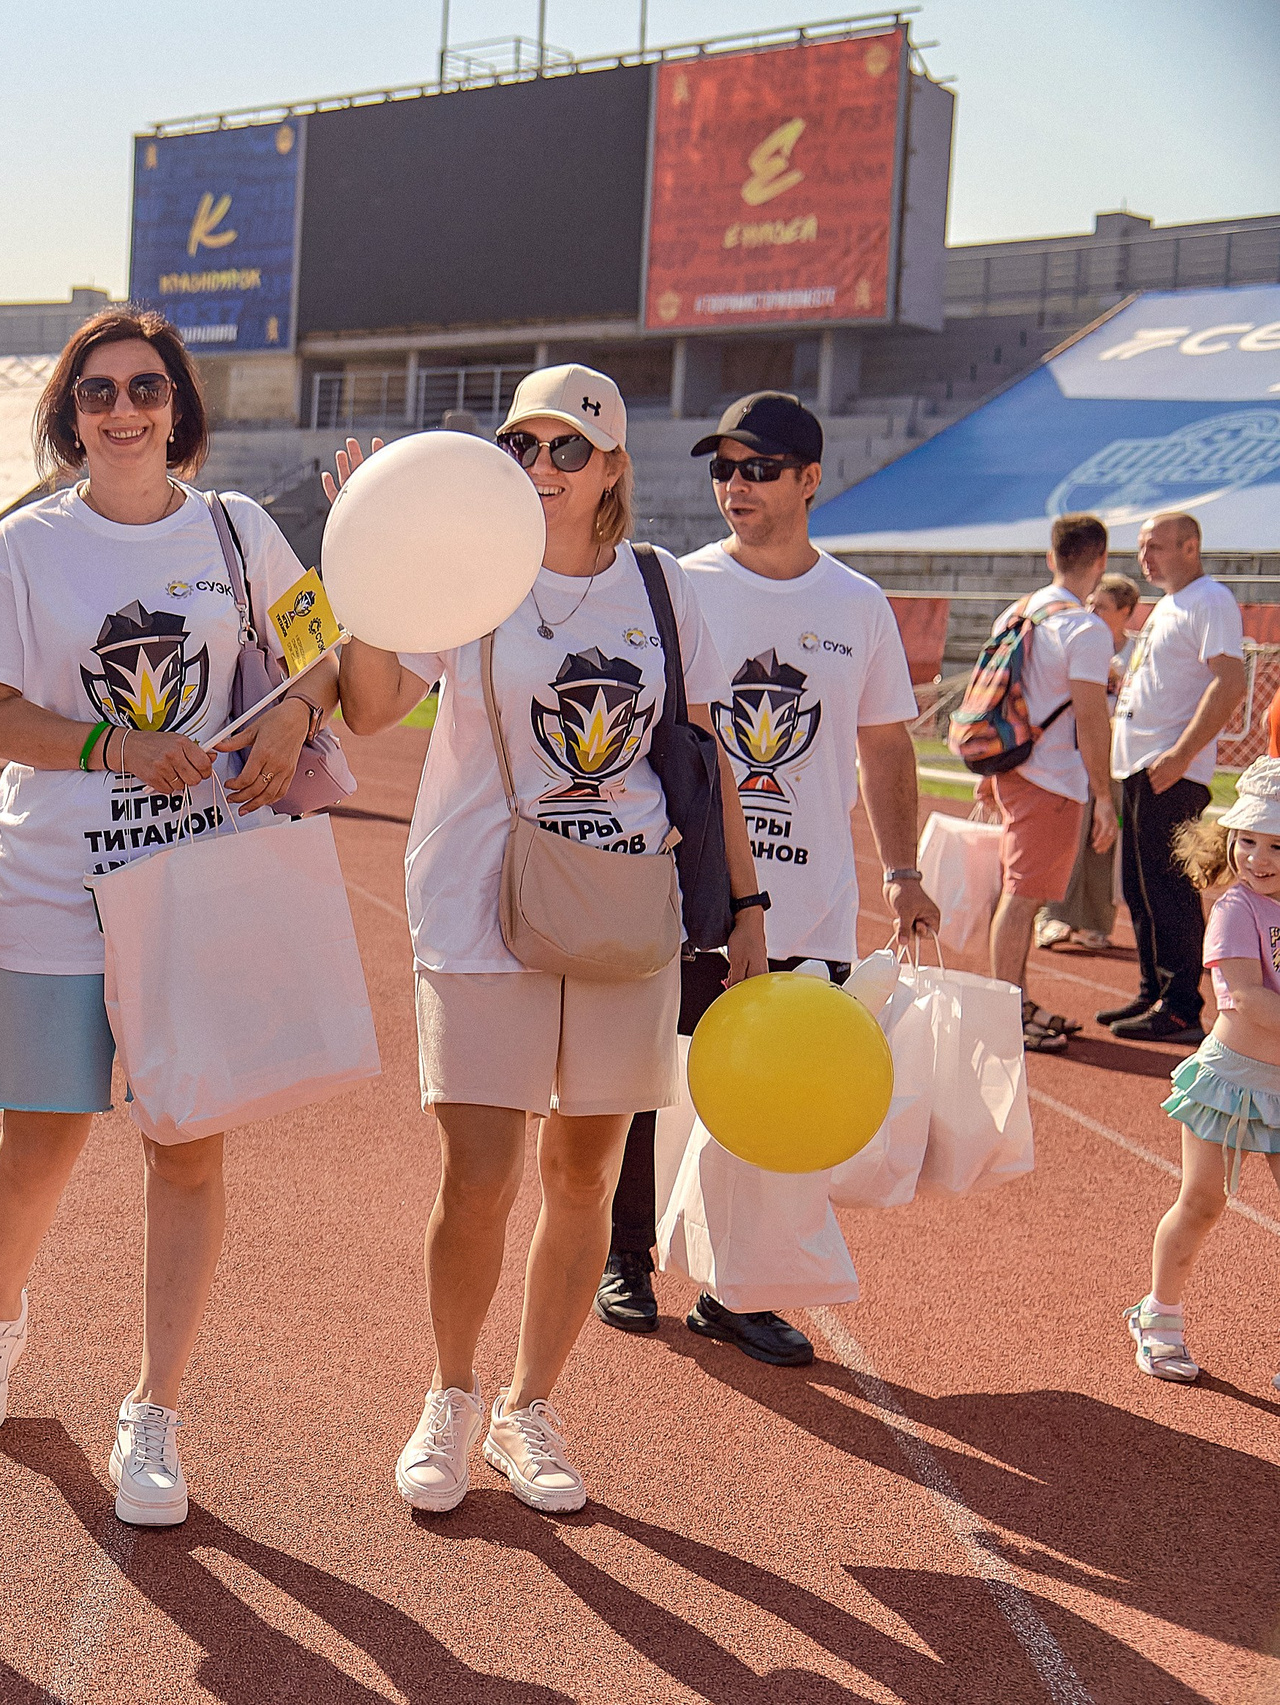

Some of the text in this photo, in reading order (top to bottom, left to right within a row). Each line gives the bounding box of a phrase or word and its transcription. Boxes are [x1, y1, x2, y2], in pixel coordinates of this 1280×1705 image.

[196, 581, 234, 598] СУЭК
[823, 640, 853, 657] СУЭК
[111, 786, 193, 821] ИГРЫ
[84, 805, 224, 853] ТИТАНОВ
[745, 816, 791, 838] ГРЫ
